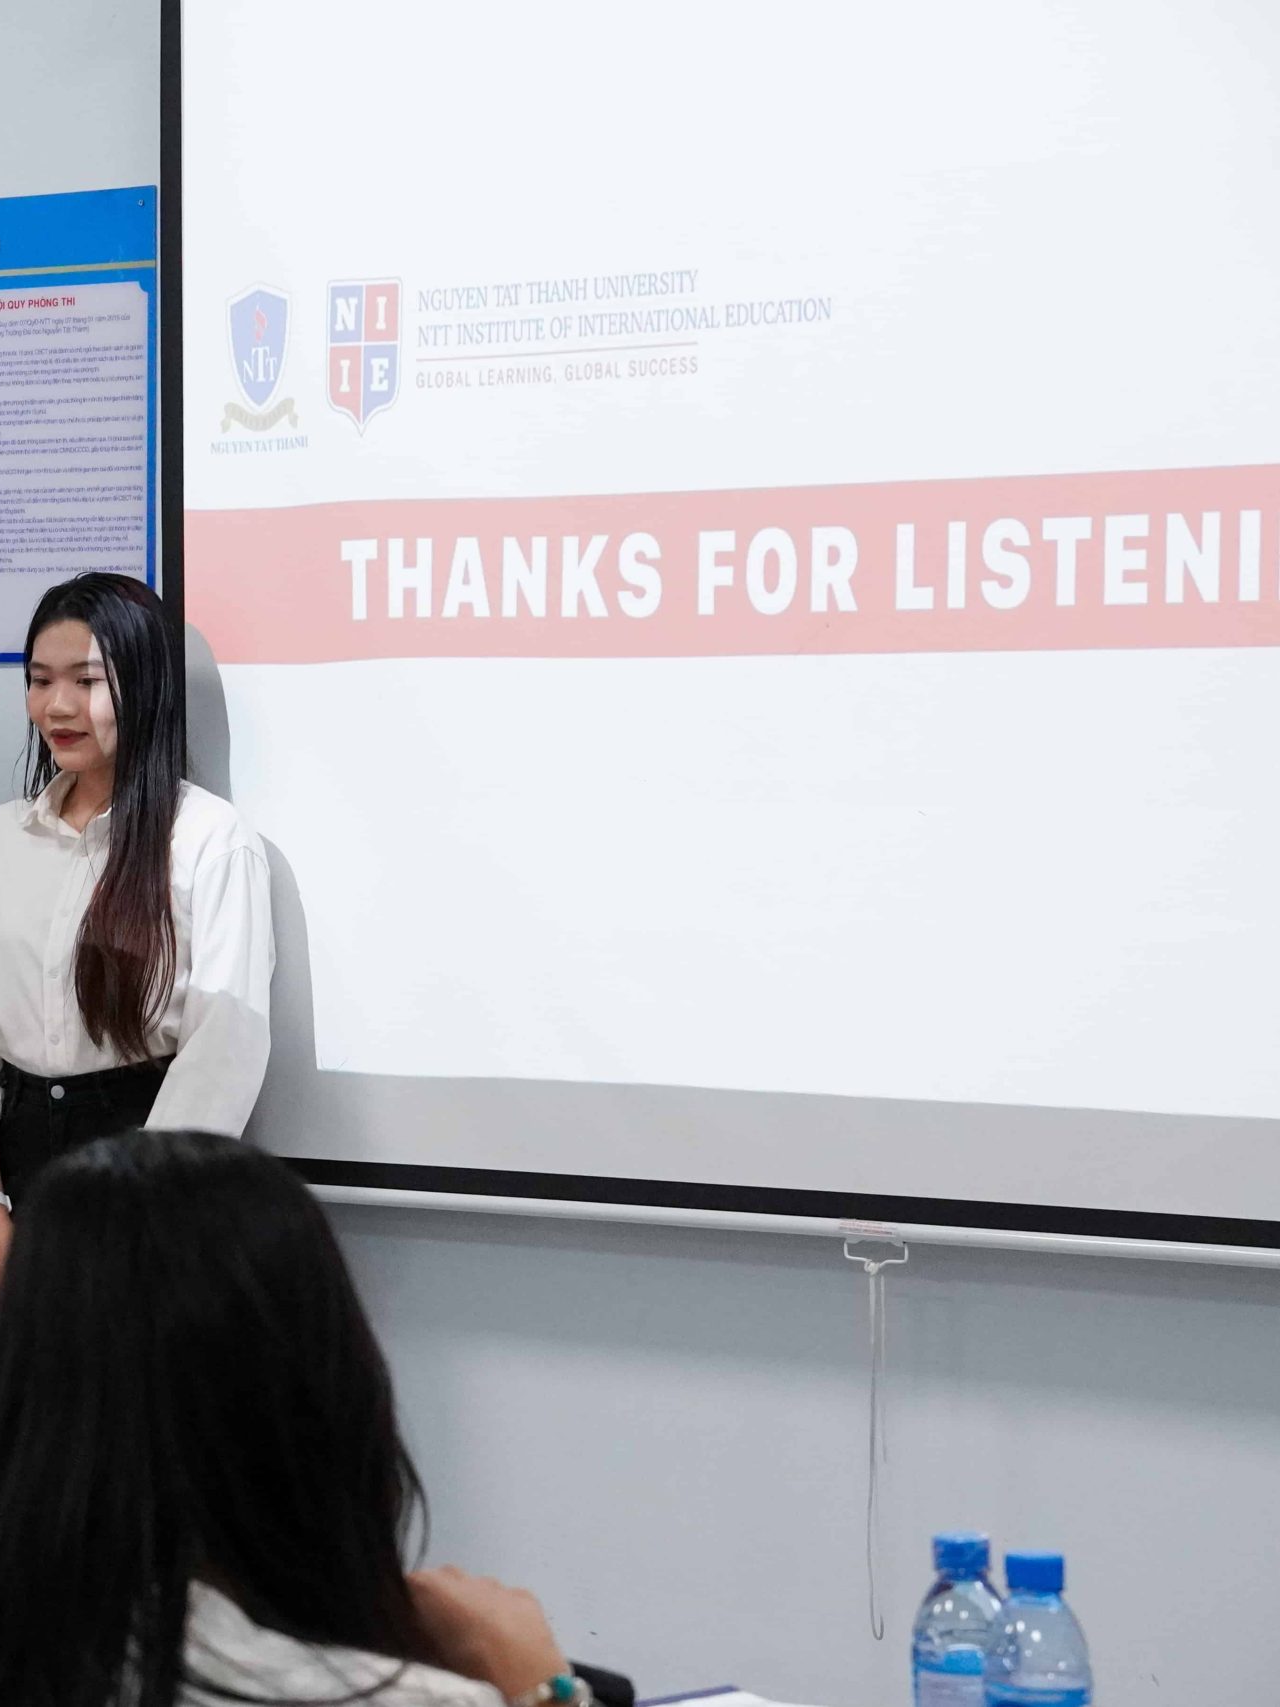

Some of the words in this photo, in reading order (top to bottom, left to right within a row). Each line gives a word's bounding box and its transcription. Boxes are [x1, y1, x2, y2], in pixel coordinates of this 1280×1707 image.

[8, 300, 26, 311] QUY
[28, 298, 59, 308] PHÒNG
[61, 297, 76, 306] THI
[417, 286, 488, 312] NGUYEN
[492, 282, 522, 307] TAT
[526, 278, 588, 304] THANH
[593, 269, 698, 300] UNIVERSITY
[417, 324, 452, 348] NTT
[457, 318, 546, 345] INSTITUTE
[550, 316, 573, 340] OF
[578, 305, 720, 337] INTERNATIONAL
[724, 297, 832, 328] EDUCATION
[416, 370, 472, 389] GLOBAL
[479, 366, 557, 386] LEARNING,
[564, 361, 622, 382] GLOBAL
[628, 356, 699, 378] SUCCESS
[210, 440, 253, 455] NGUYEN
[253, 439, 273, 453] TAT
[276, 435, 308, 451] THANH
[340, 532, 663, 621] THANKS
[696, 526, 859, 617] FOR
[895, 510, 1280, 612] LISTENI
